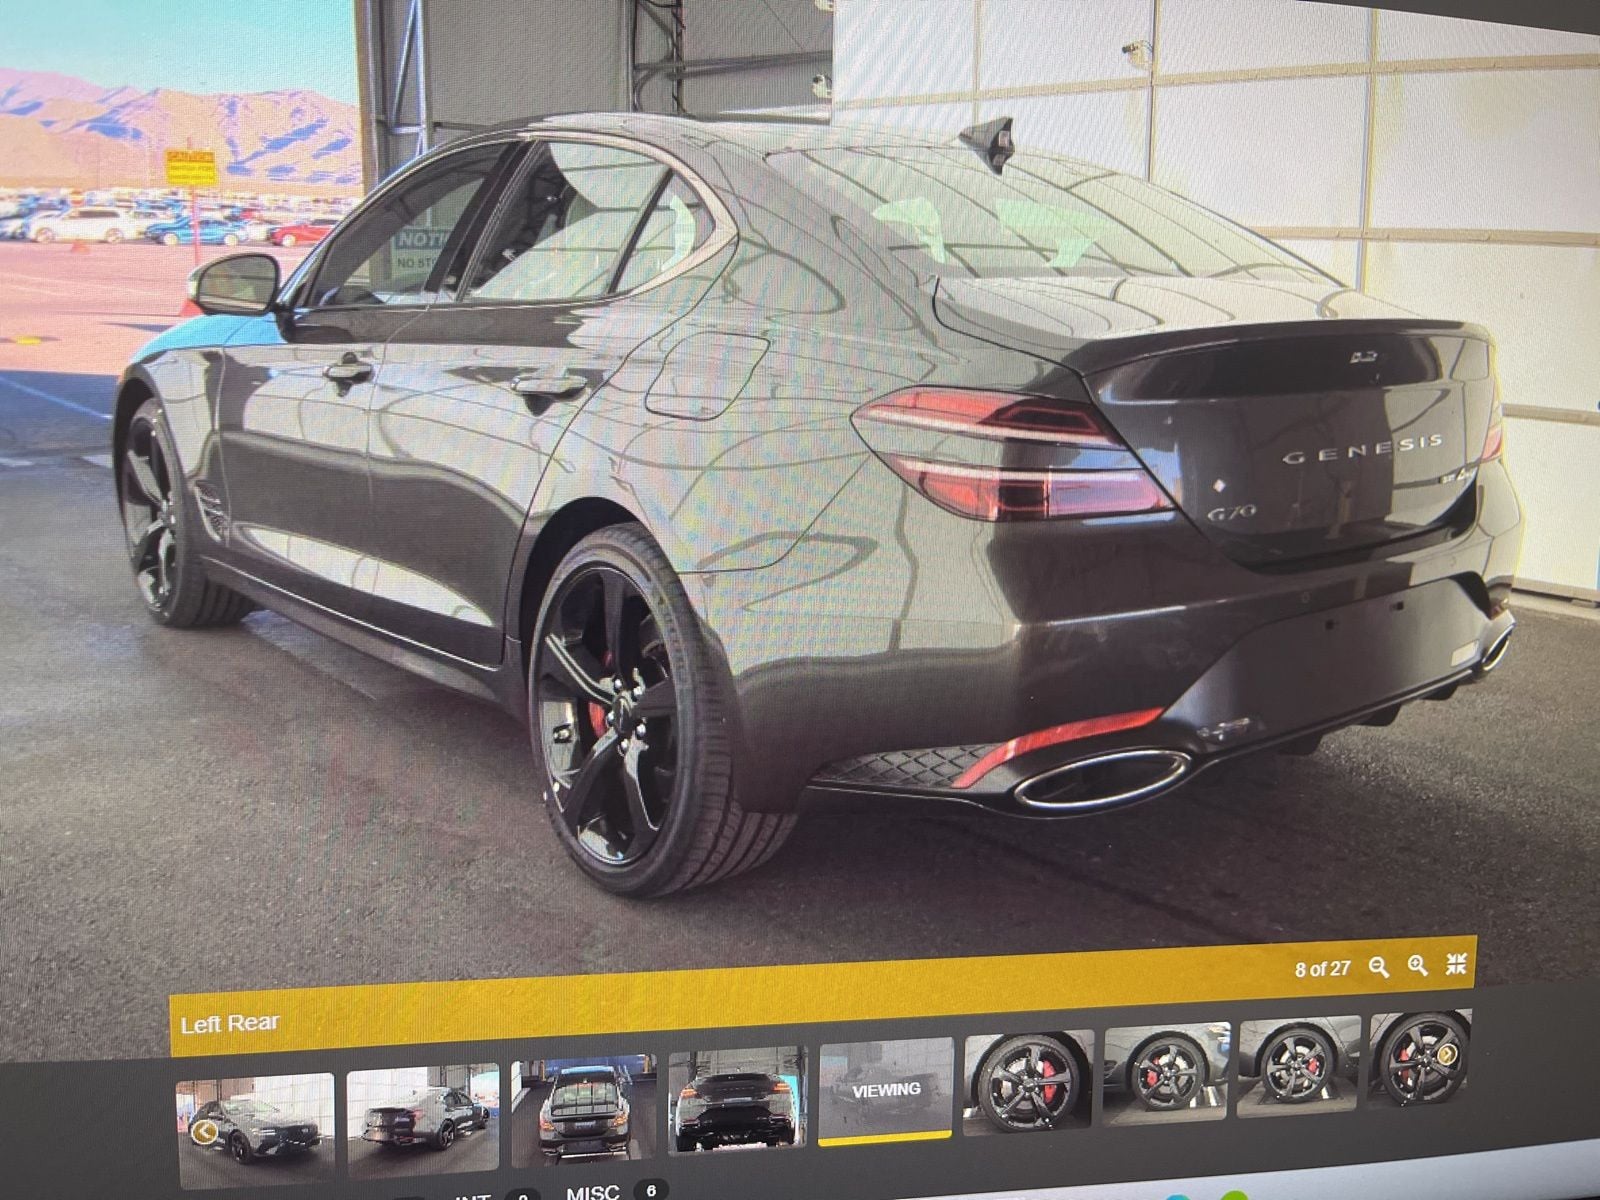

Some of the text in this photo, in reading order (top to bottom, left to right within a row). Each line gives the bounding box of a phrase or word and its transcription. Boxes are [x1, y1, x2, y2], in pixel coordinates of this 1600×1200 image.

[397, 257, 415, 269] NO
[1282, 433, 1442, 465] GENESIS
[1207, 504, 1256, 522] G70
[1295, 960, 1352, 977] 8 of 27
[180, 1013, 281, 1034] Left Rear
[852, 1082, 922, 1099] VIEWING
[566, 1184, 657, 1200] MISC 6
